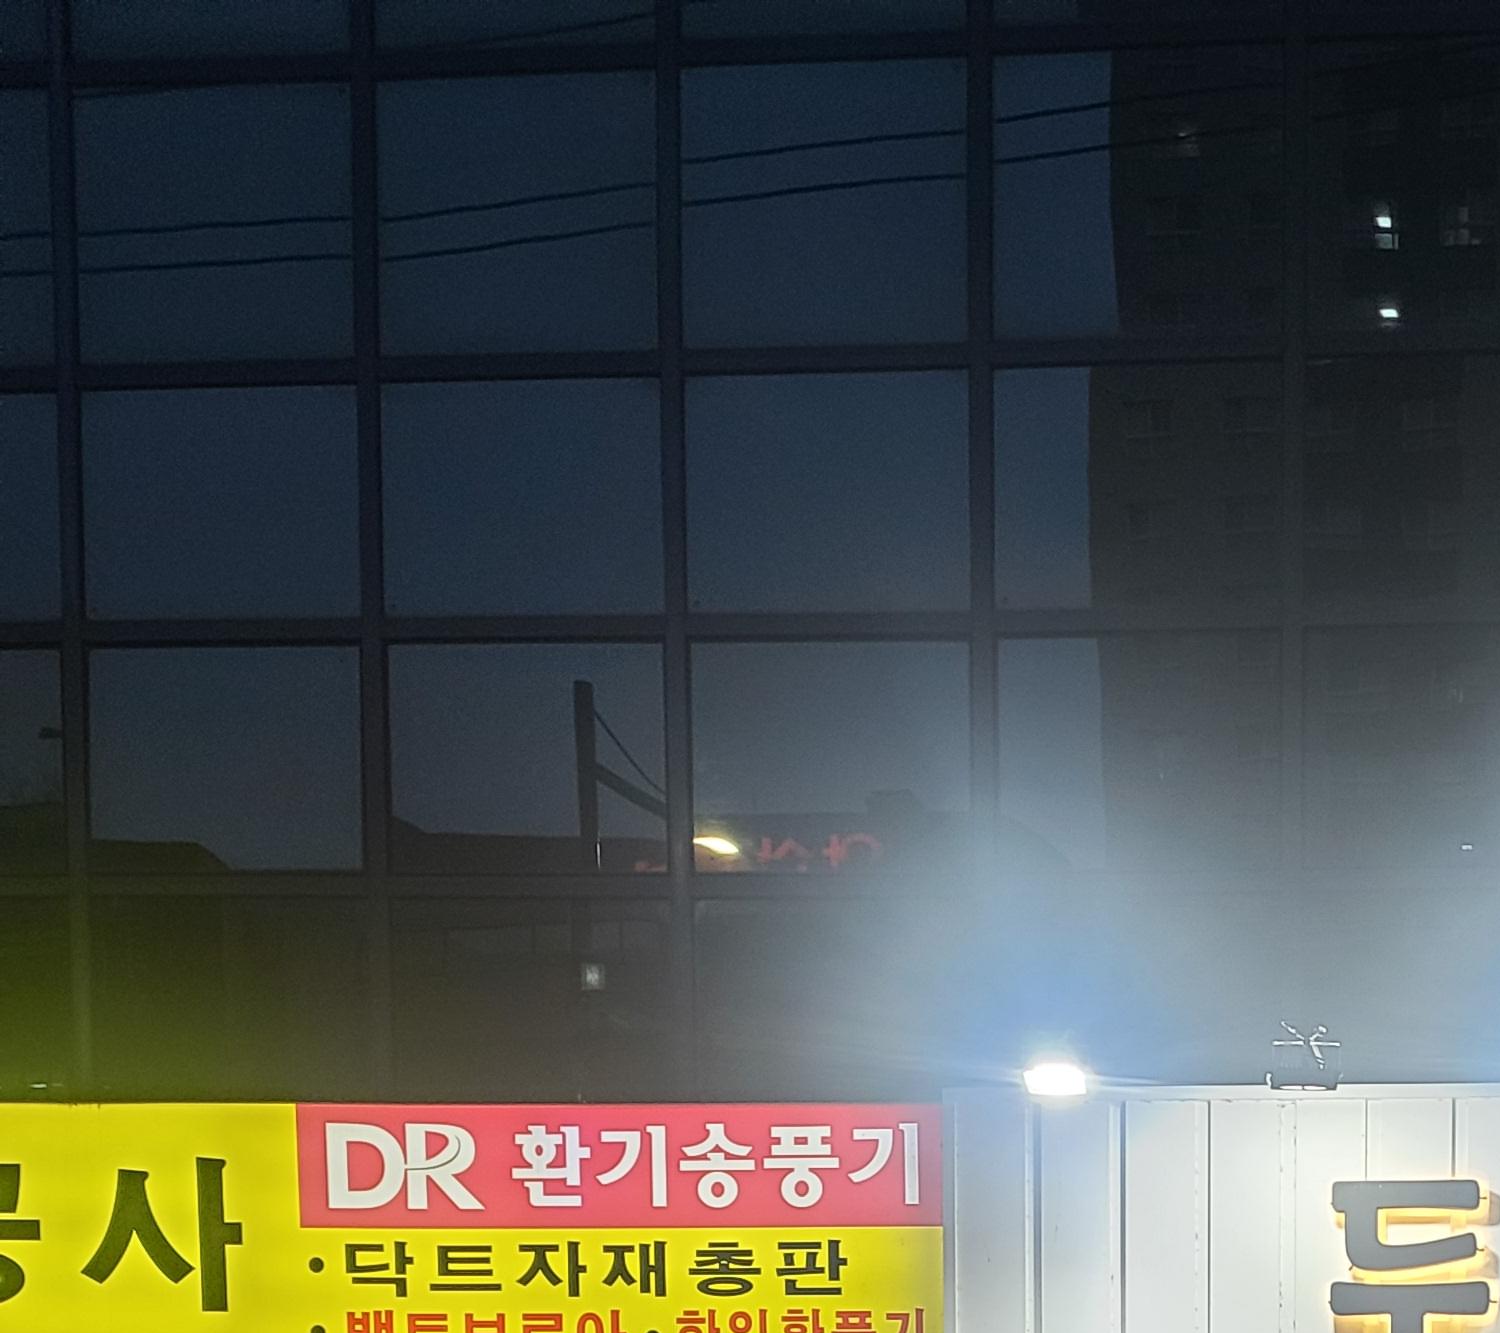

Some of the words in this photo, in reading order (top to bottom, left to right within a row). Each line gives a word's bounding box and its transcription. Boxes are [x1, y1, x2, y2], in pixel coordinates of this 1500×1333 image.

[325, 1121, 485, 1211] DR
[512, 1121, 922, 1209] 환기송풍기
[345, 1239, 848, 1298] 닥트자재총판
